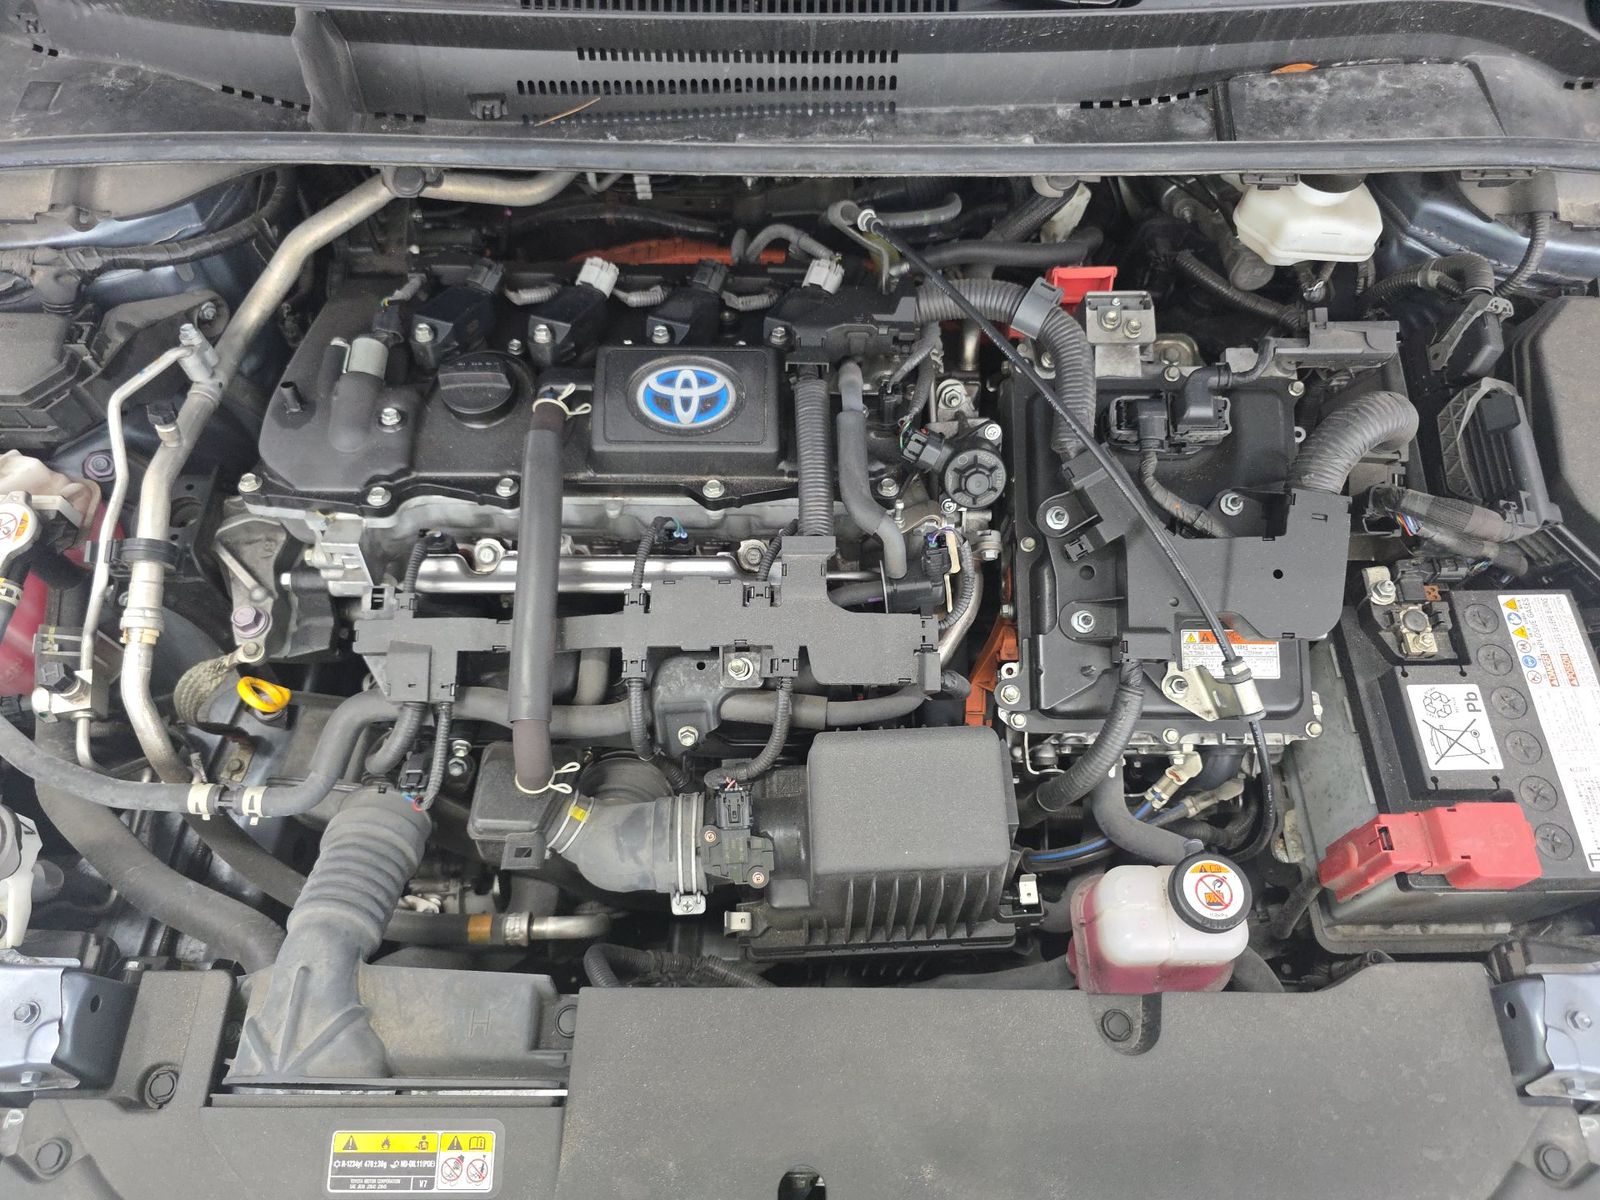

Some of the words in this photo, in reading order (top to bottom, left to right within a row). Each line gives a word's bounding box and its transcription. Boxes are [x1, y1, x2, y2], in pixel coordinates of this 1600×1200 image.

[1523, 597, 1534, 618] GASES
[1532, 620, 1547, 653] EXPLOSIVE
[1541, 654, 1556, 680] DANGER
[1561, 654, 1576, 680] POISON
[1464, 692, 1482, 713] Pb
